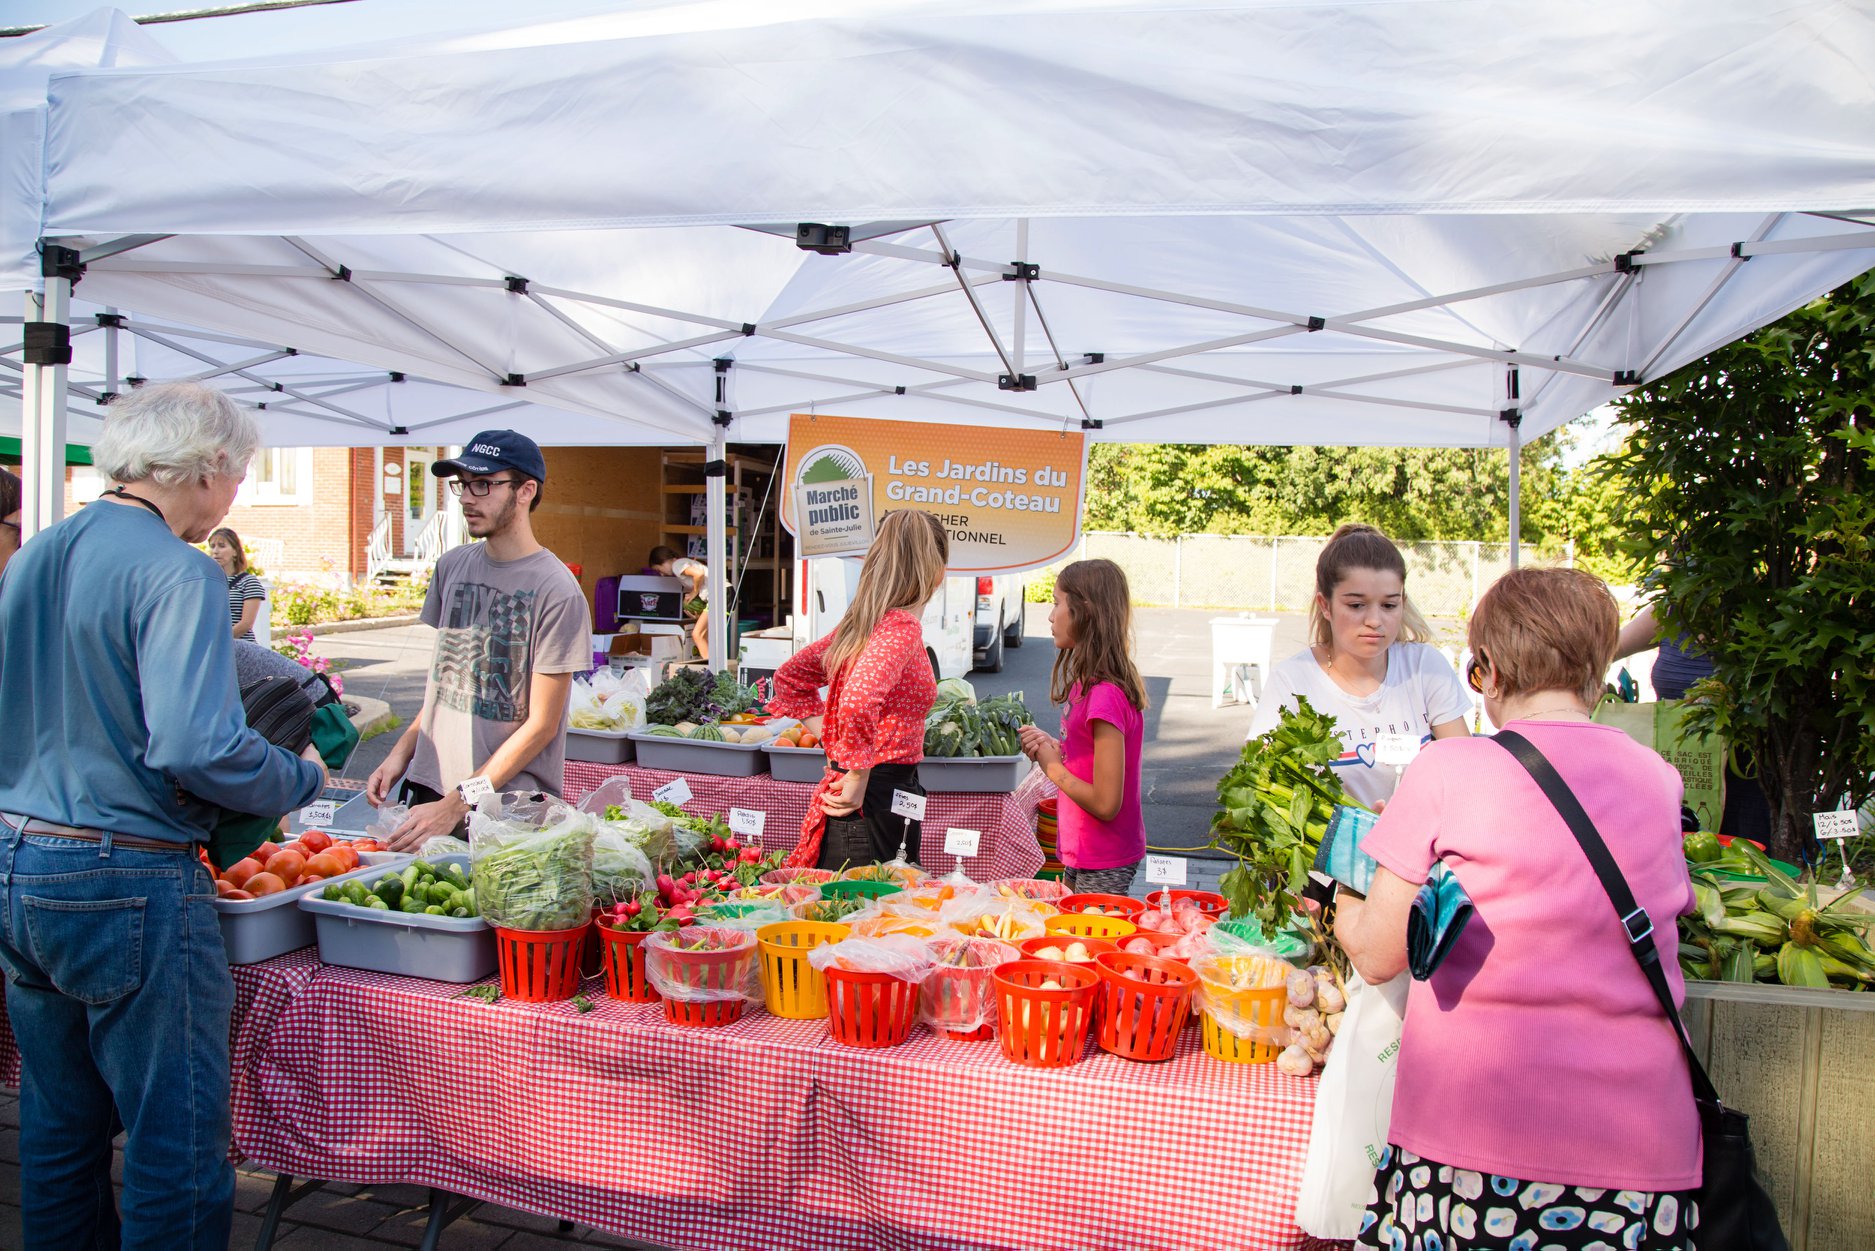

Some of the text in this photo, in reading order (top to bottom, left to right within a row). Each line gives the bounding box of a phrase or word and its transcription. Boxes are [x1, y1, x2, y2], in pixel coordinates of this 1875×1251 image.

[471, 443, 501, 457] NGCC
[888, 455, 1067, 488] Les Jardins du
[807, 485, 858, 505] Marché
[886, 480, 1061, 513] Grand-Coteau
[809, 503, 859, 526] public
[820, 524, 862, 535] Sainte-Julie
[946, 529, 1006, 545] TIONNEL
[1364, 1144, 1380, 1169] RES
